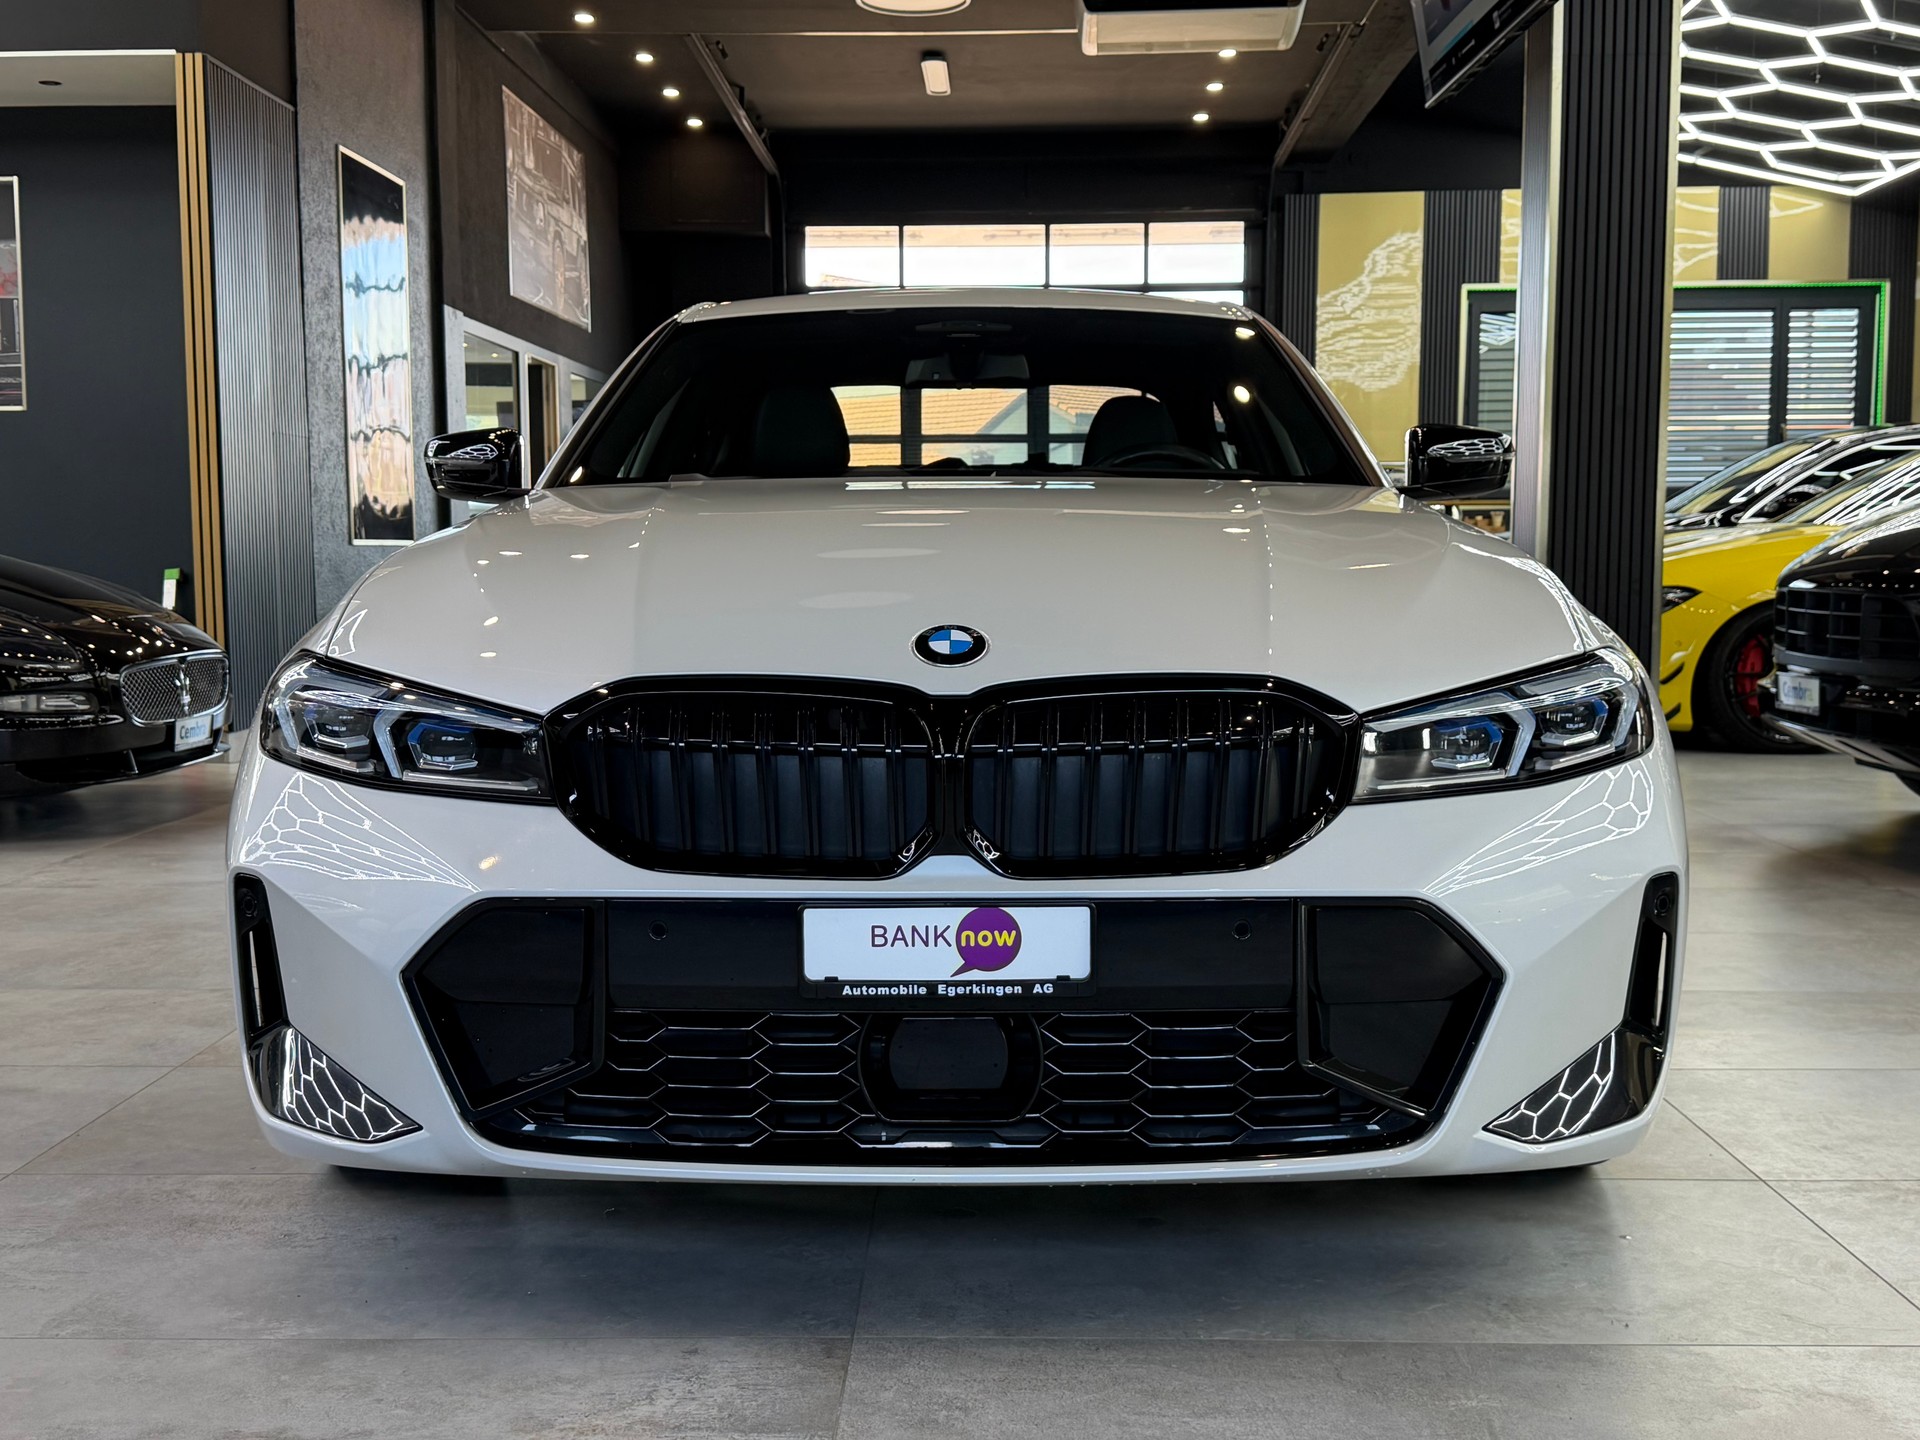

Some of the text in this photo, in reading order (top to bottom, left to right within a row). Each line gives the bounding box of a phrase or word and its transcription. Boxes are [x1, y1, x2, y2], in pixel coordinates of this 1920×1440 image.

[179, 721, 208, 740] Cembra
[870, 924, 1017, 948] BANK now
[842, 984, 1054, 997] Automobile Egerkingen AG
